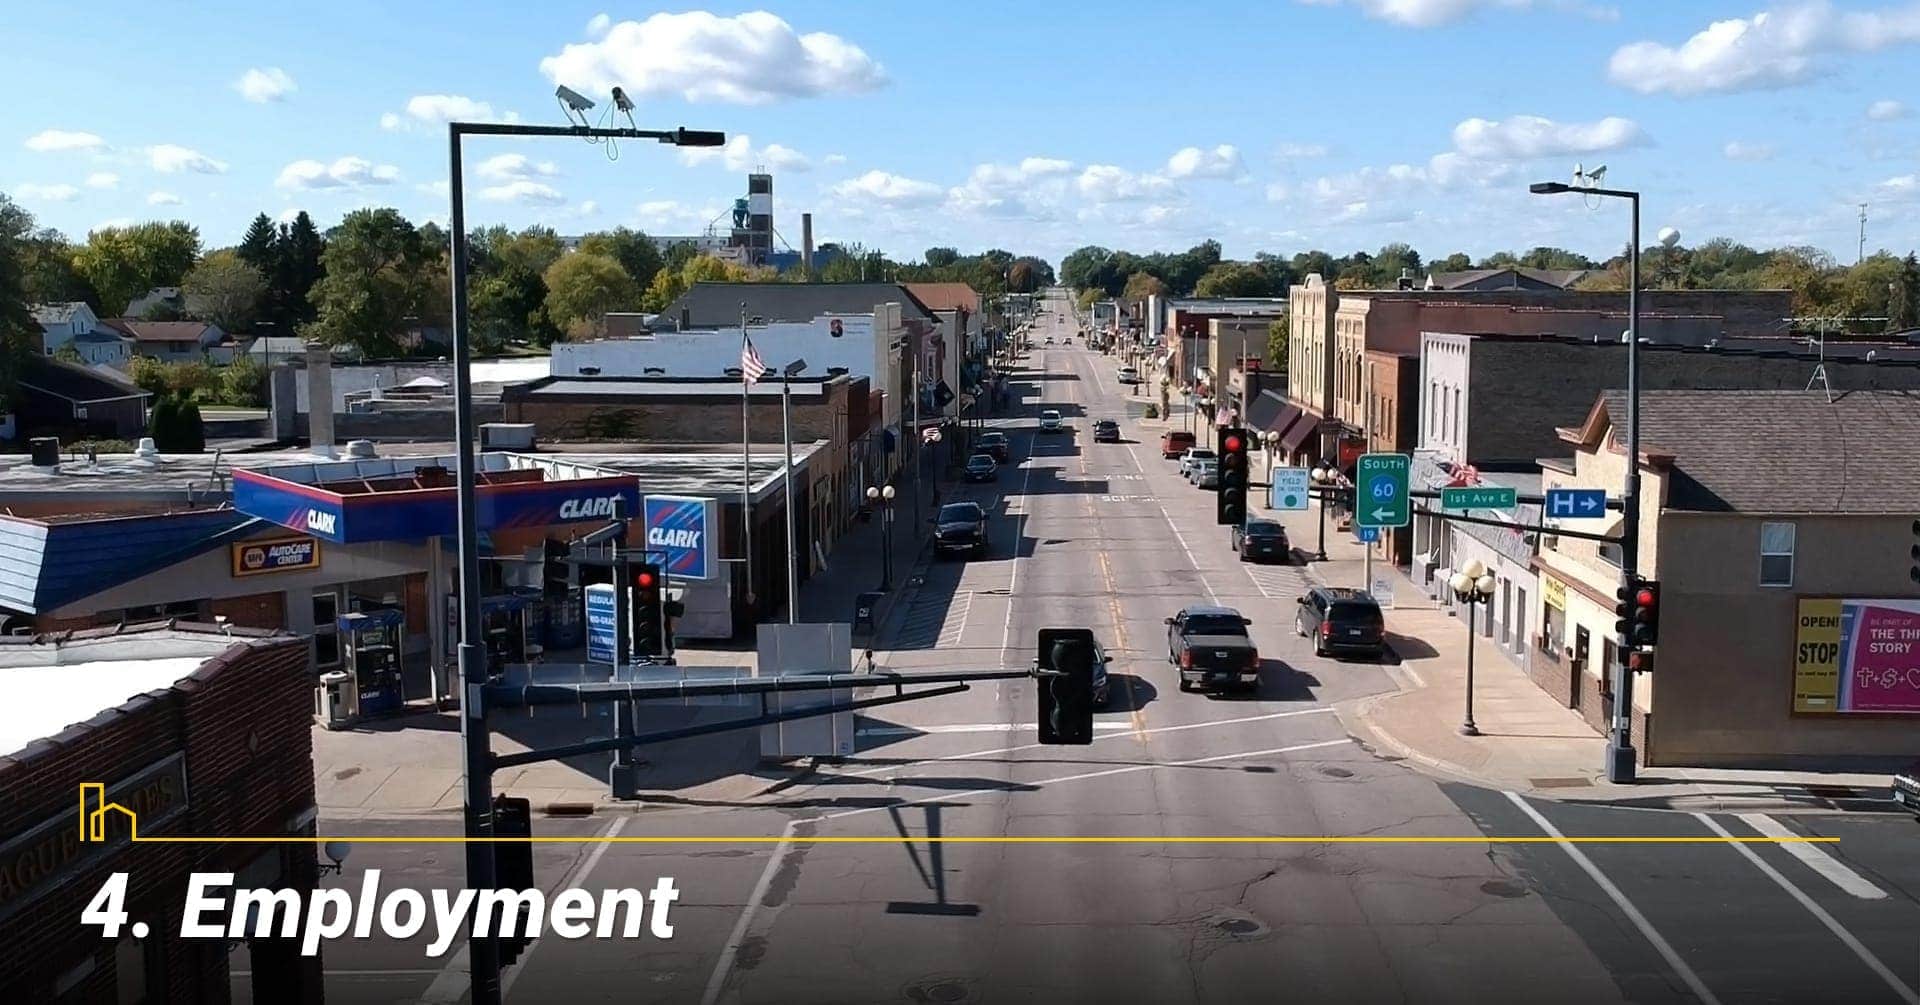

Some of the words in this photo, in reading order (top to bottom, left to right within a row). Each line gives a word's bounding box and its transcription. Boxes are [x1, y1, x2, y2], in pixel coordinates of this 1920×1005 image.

[1364, 459, 1405, 469] SOUTH
[1373, 483, 1394, 497] 60
[1473, 495, 1495, 503] Ave
[307, 508, 336, 534] CLARK
[649, 527, 701, 549] CLARK
[1363, 530, 1375, 539] 19
[588, 594, 614, 605] REGULA
[1870, 629, 1895, 640] THE
[590, 635, 614, 646] PREMIU
[1799, 643, 1838, 664] STOP
[1869, 642, 1912, 654] STORY
